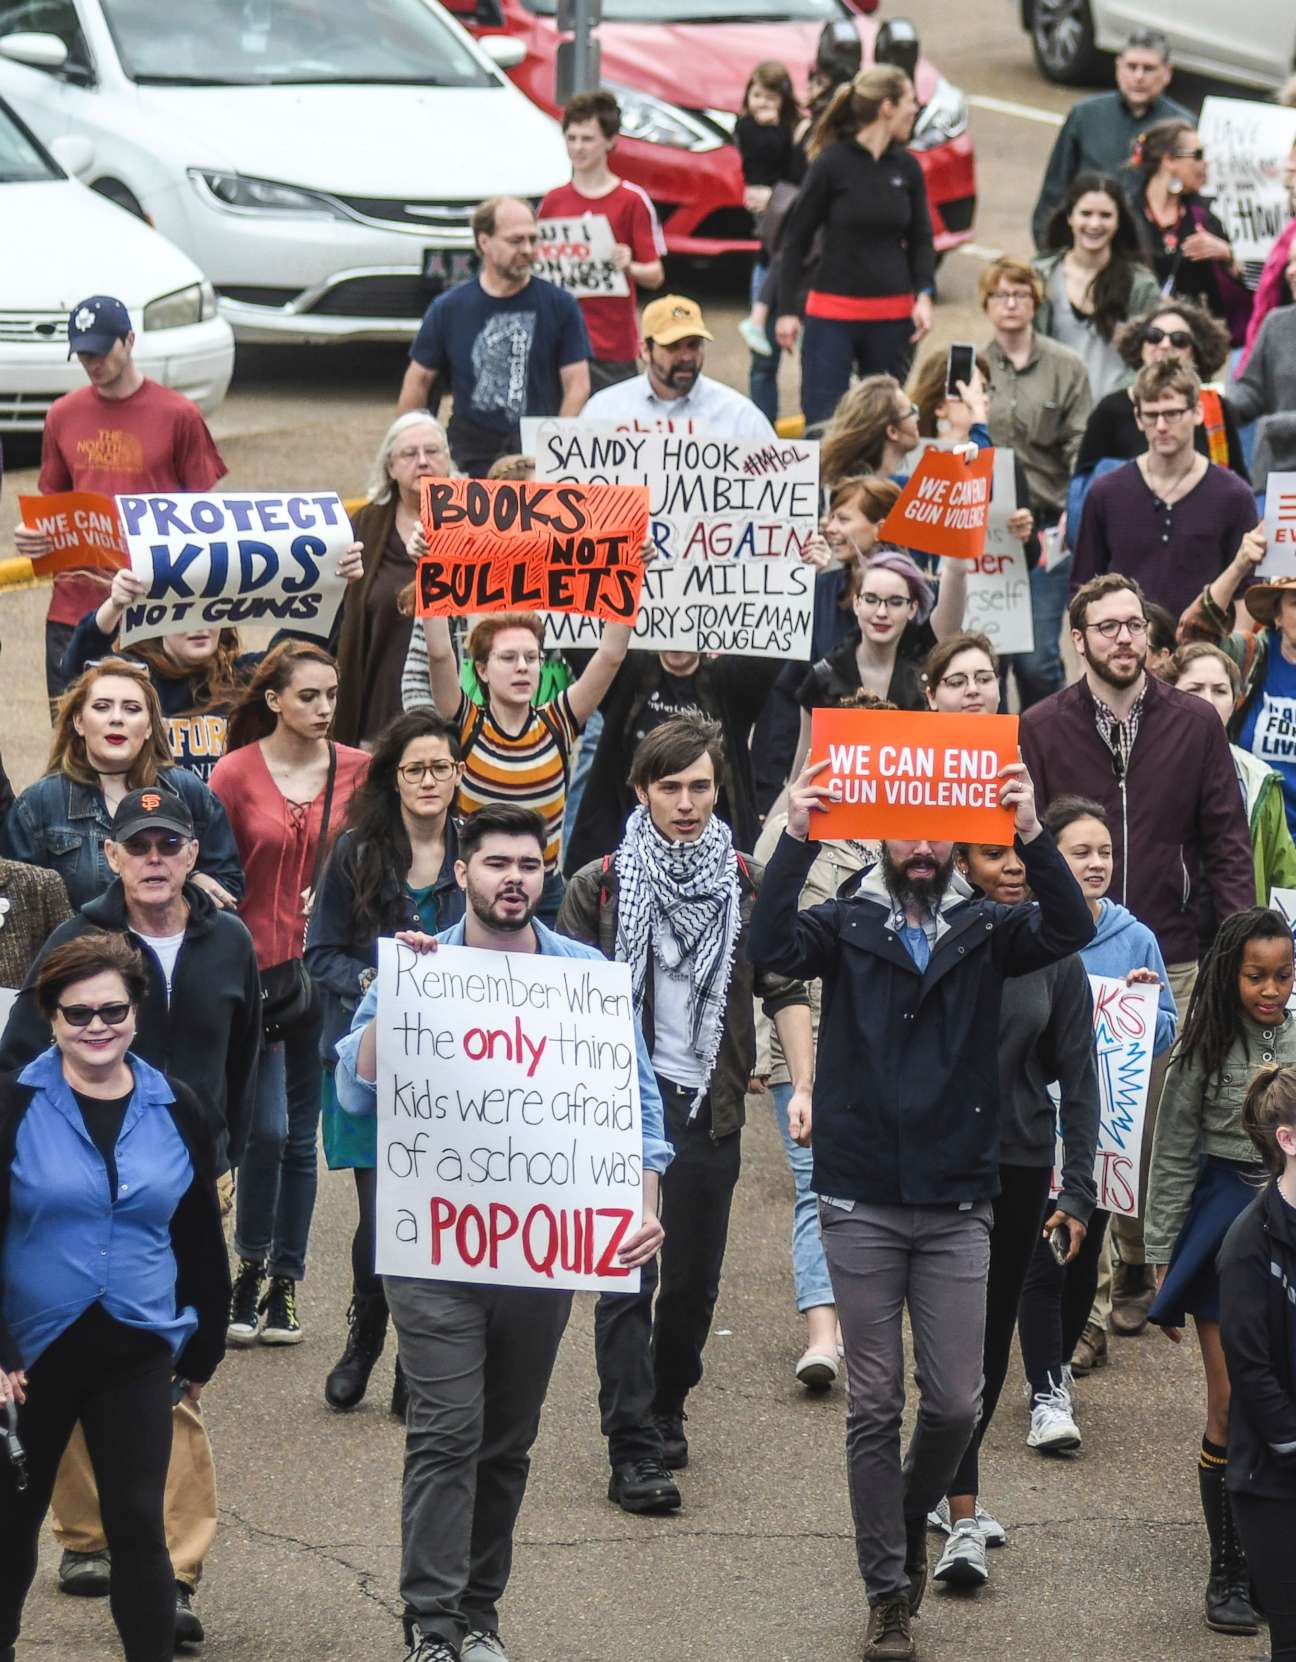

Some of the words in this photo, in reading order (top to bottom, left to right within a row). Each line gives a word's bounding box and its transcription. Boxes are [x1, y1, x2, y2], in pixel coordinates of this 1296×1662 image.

[76, 440, 122, 453] NORTH
[97, 429, 122, 441] THE
[87, 452, 121, 464] FACE
[546, 435, 646, 474] SANDY
[662, 438, 740, 473] HOOK
[917, 475, 950, 500] WE
[35, 513, 69, 535] WE
[74, 510, 113, 534] CAN
[120, 496, 340, 537] PROTECT
[429, 480, 587, 534] BOOKS
[904, 500, 945, 525] GUN
[944, 506, 986, 529] VIOLENCE
[550, 536, 628, 566] NOT
[683, 521, 813, 561] AGAIN
[146, 534, 327, 600] KIDS
[683, 564, 808, 599] MILLS
[421, 562, 637, 617] BULLETS
[125, 602, 195, 633] NOT
[202, 593, 322, 622] GUNS
[680, 602, 812, 637] STONEMAN
[697, 630, 792, 652] DOUGLAS
[829, 744, 872, 776] WE
[879, 746, 935, 778] CAN
[943, 749, 999, 780] END
[829, 778, 877, 804] GUN
[884, 780, 997, 808] VIOLENCE
[395, 943, 562, 1008] Remember
[562, 971, 632, 1020] When
[393, 1011, 456, 1060] the
[463, 1015, 548, 1078] only
[547, 1022, 632, 1091] thing
[456, 1087, 544, 1126] were
[551, 1082, 633, 1132] afraid
[435, 1147, 464, 1182] a
[466, 1135, 577, 1186] school
[590, 1150, 642, 1188] was
[395, 1208, 418, 1244] a
[430, 1196, 520, 1269] POP
[521, 1202, 635, 1279] QUIZ
